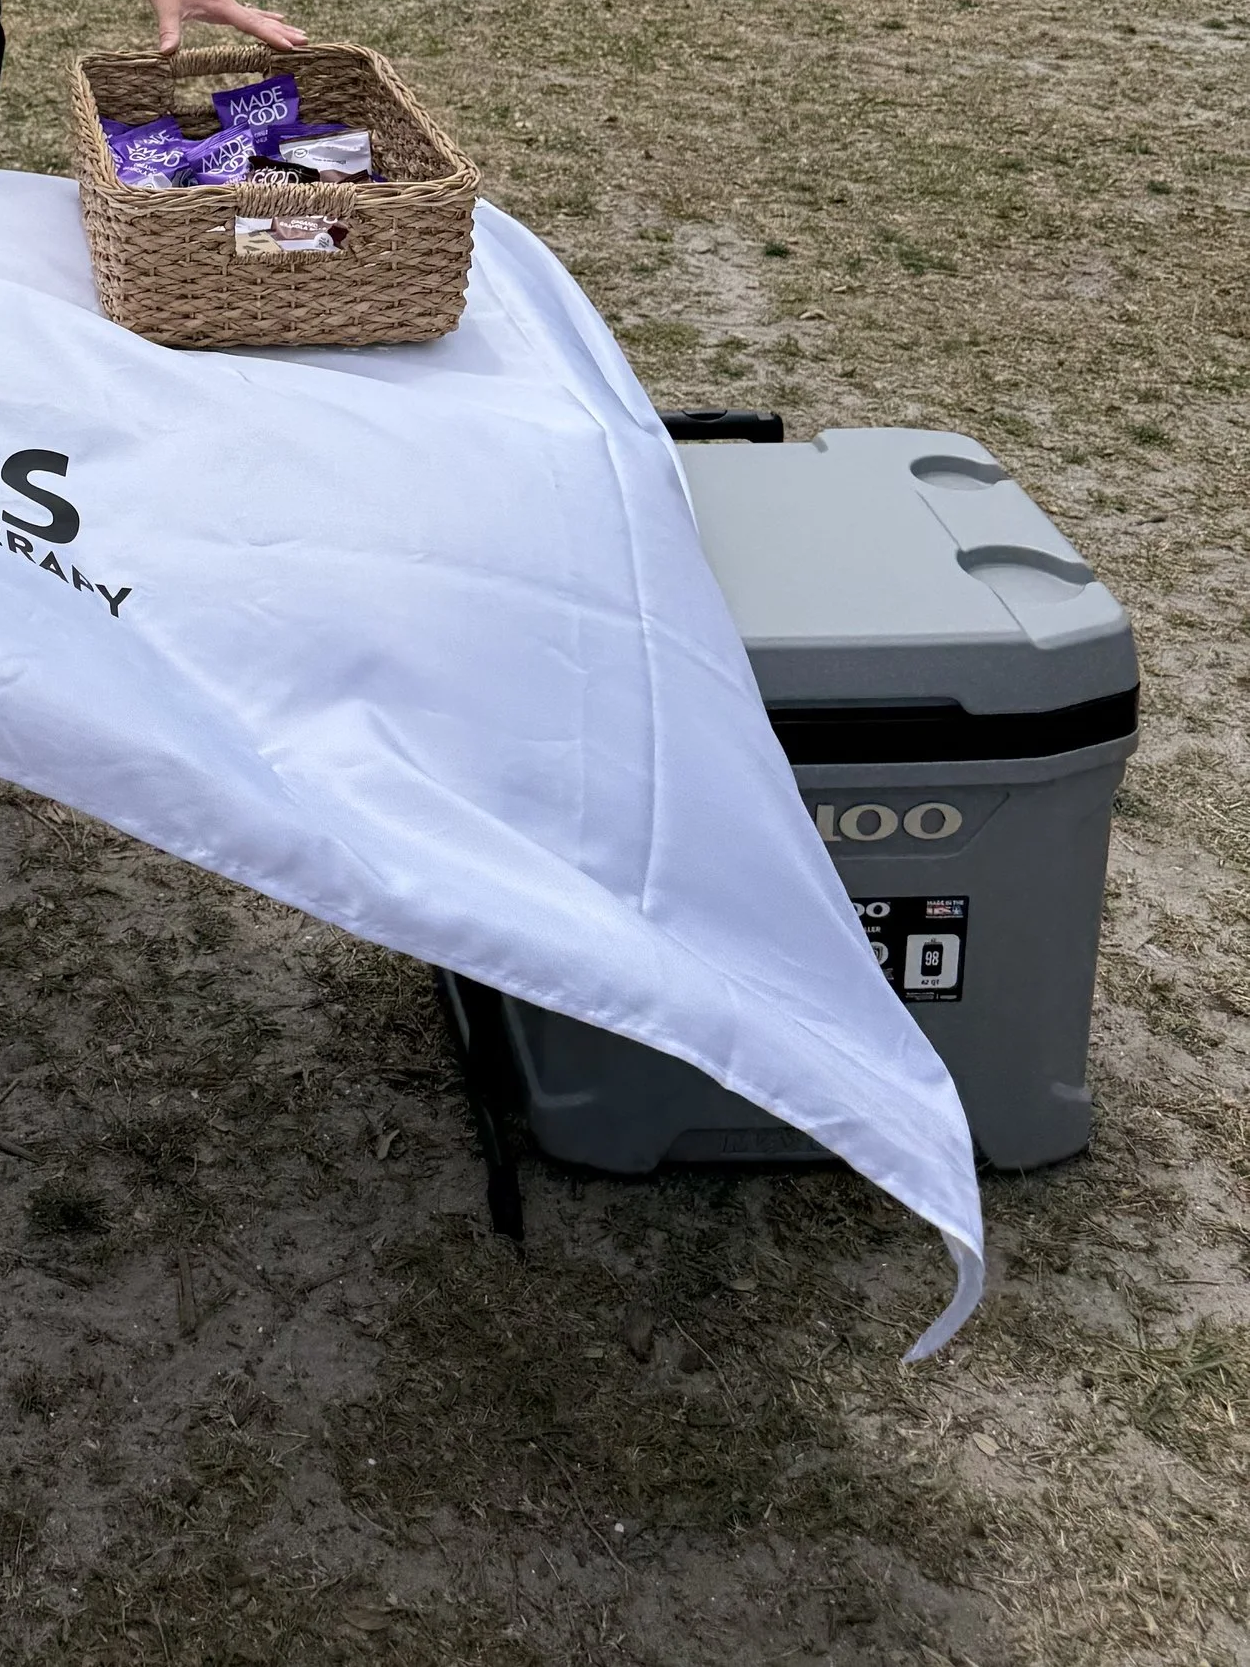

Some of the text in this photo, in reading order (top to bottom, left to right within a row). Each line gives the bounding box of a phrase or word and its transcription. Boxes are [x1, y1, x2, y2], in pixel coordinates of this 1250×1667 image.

[229, 85, 285, 116] MADE
[201, 134, 253, 174] MADE
[252, 170, 299, 185] GOOD
[816, 802, 963, 841] LOO
[925, 951, 940, 966] 98
